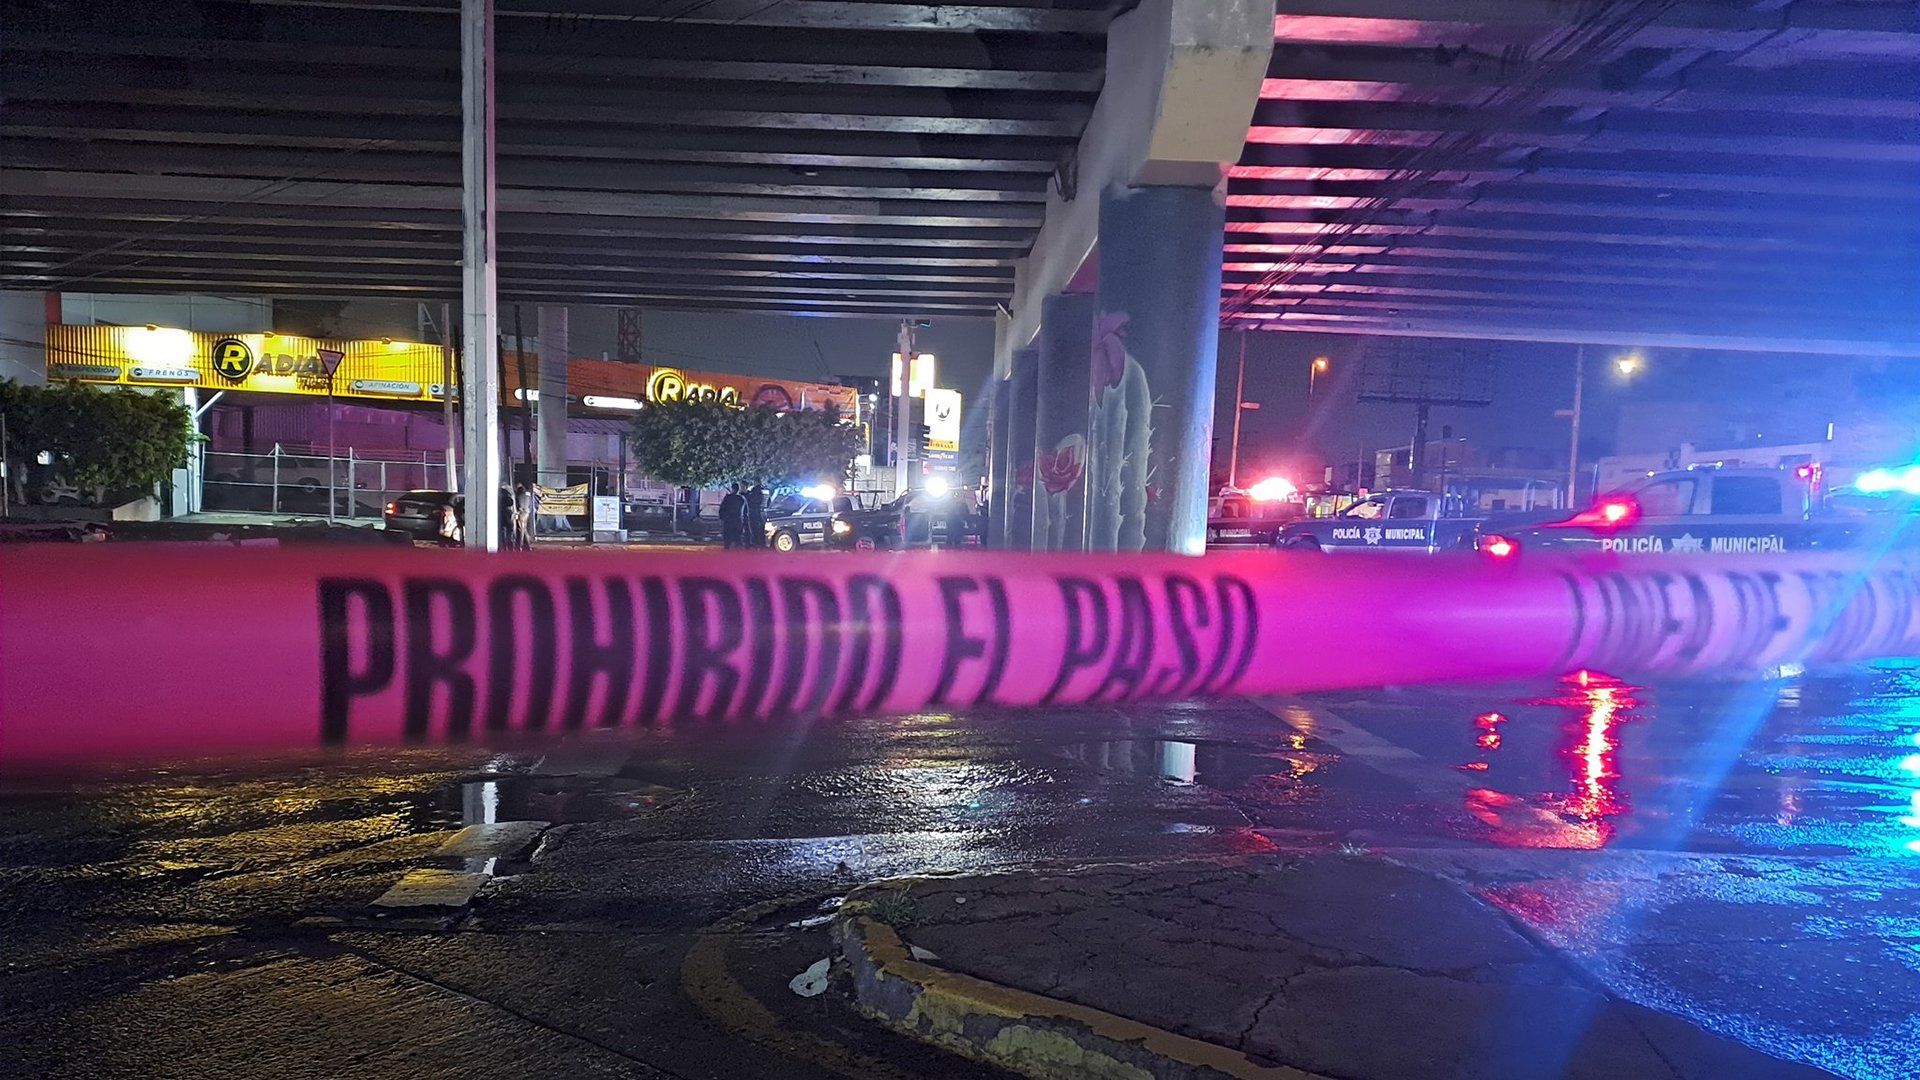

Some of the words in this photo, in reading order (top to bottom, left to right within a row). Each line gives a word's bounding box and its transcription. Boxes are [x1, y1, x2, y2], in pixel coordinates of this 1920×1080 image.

[1332, 525, 1361, 540] POLICÍA
[1385, 528, 1425, 540] MUNICIPAL
[1602, 535, 1664, 553] POLICÍA
[1710, 537, 1787, 553] MUNICIPAL
[318, 574, 904, 746] PROHIBIDO
[1038, 575, 1258, 703] PASO
